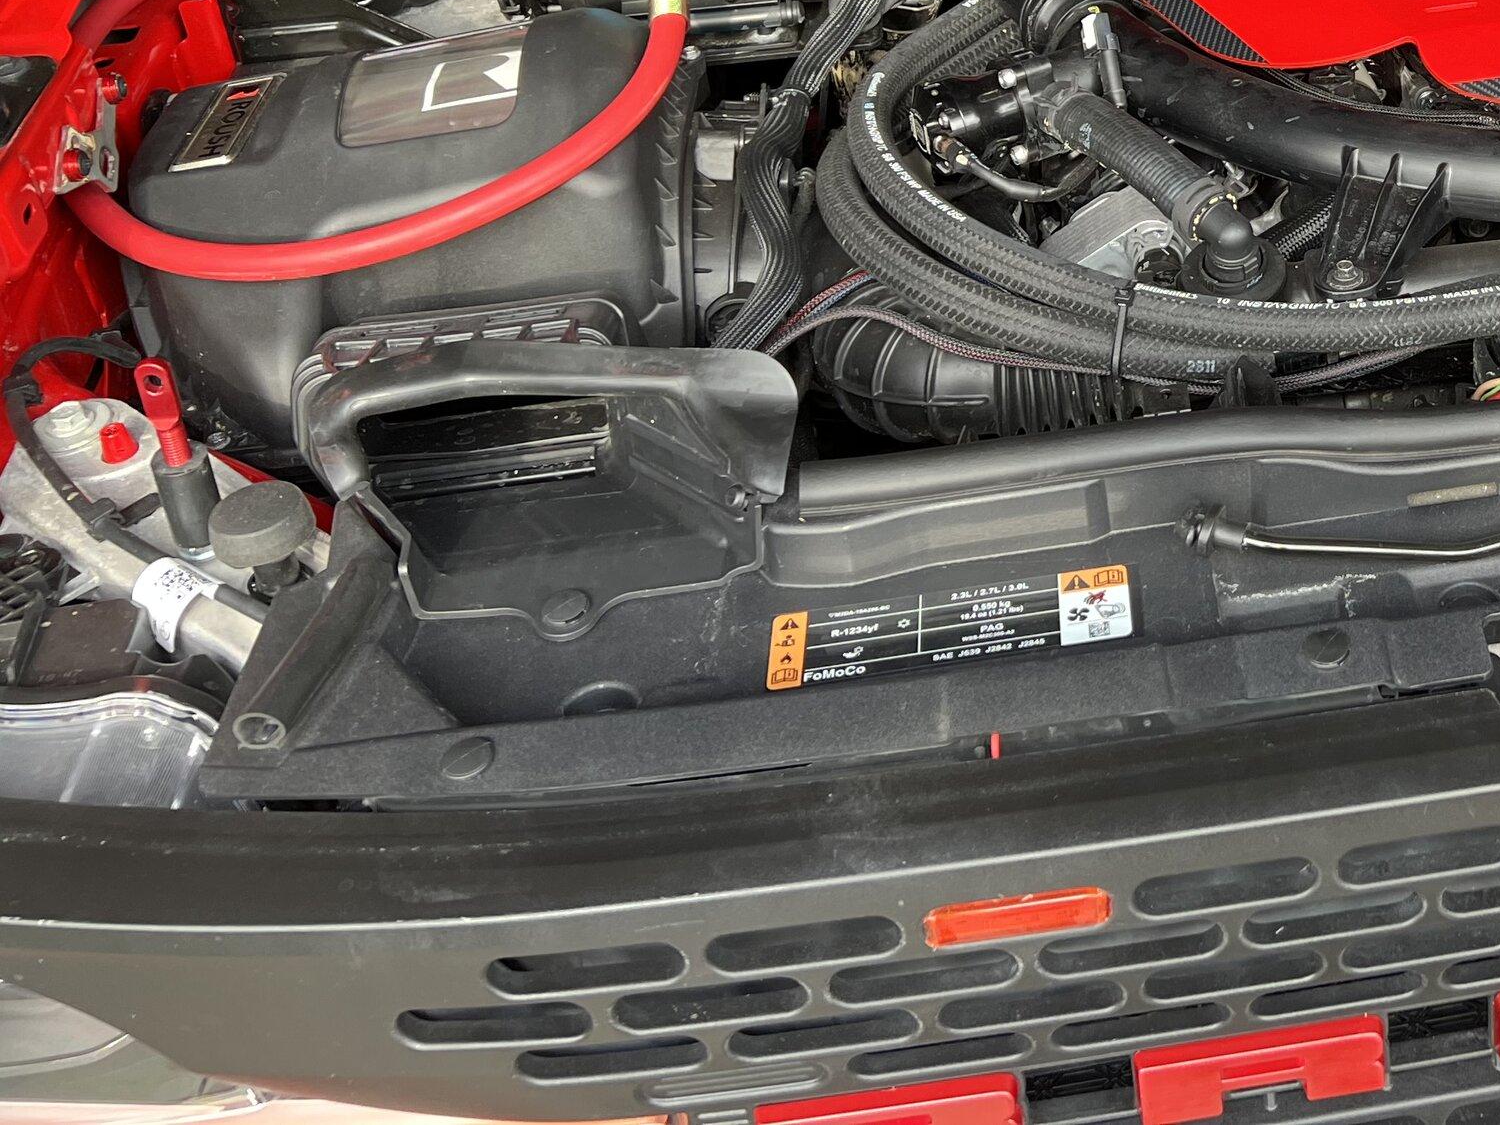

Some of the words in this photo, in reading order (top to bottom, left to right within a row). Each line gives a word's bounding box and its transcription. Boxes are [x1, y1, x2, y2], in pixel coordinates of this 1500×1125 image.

[199, 99, 254, 158] ROUSH
[917, 189, 944, 206] MADE
[946, 209, 967, 223] USA
[1216, 297, 1231, 305] 10
[1373, 299, 1393, 307] 300
[1396, 298, 1416, 306] PSI
[1417, 295, 1437, 303] WP
[1442, 289, 1479, 299] MADE
[1481, 286, 1494, 294] IN
[950, 591, 972, 601] 2.3L
[980, 587, 1001, 597] 2.7L
[972, 601, 998, 612] 0.550
[830, 623, 879, 638] R-1234yf
[980, 622, 1004, 633] PAG
[932, 651, 954, 662] SAE
[958, 648, 981, 658] J639
[985, 643, 1012, 654] J2842
[1018, 638, 1045, 649] J2845
[803, 664, 866, 683] FoMoCo
